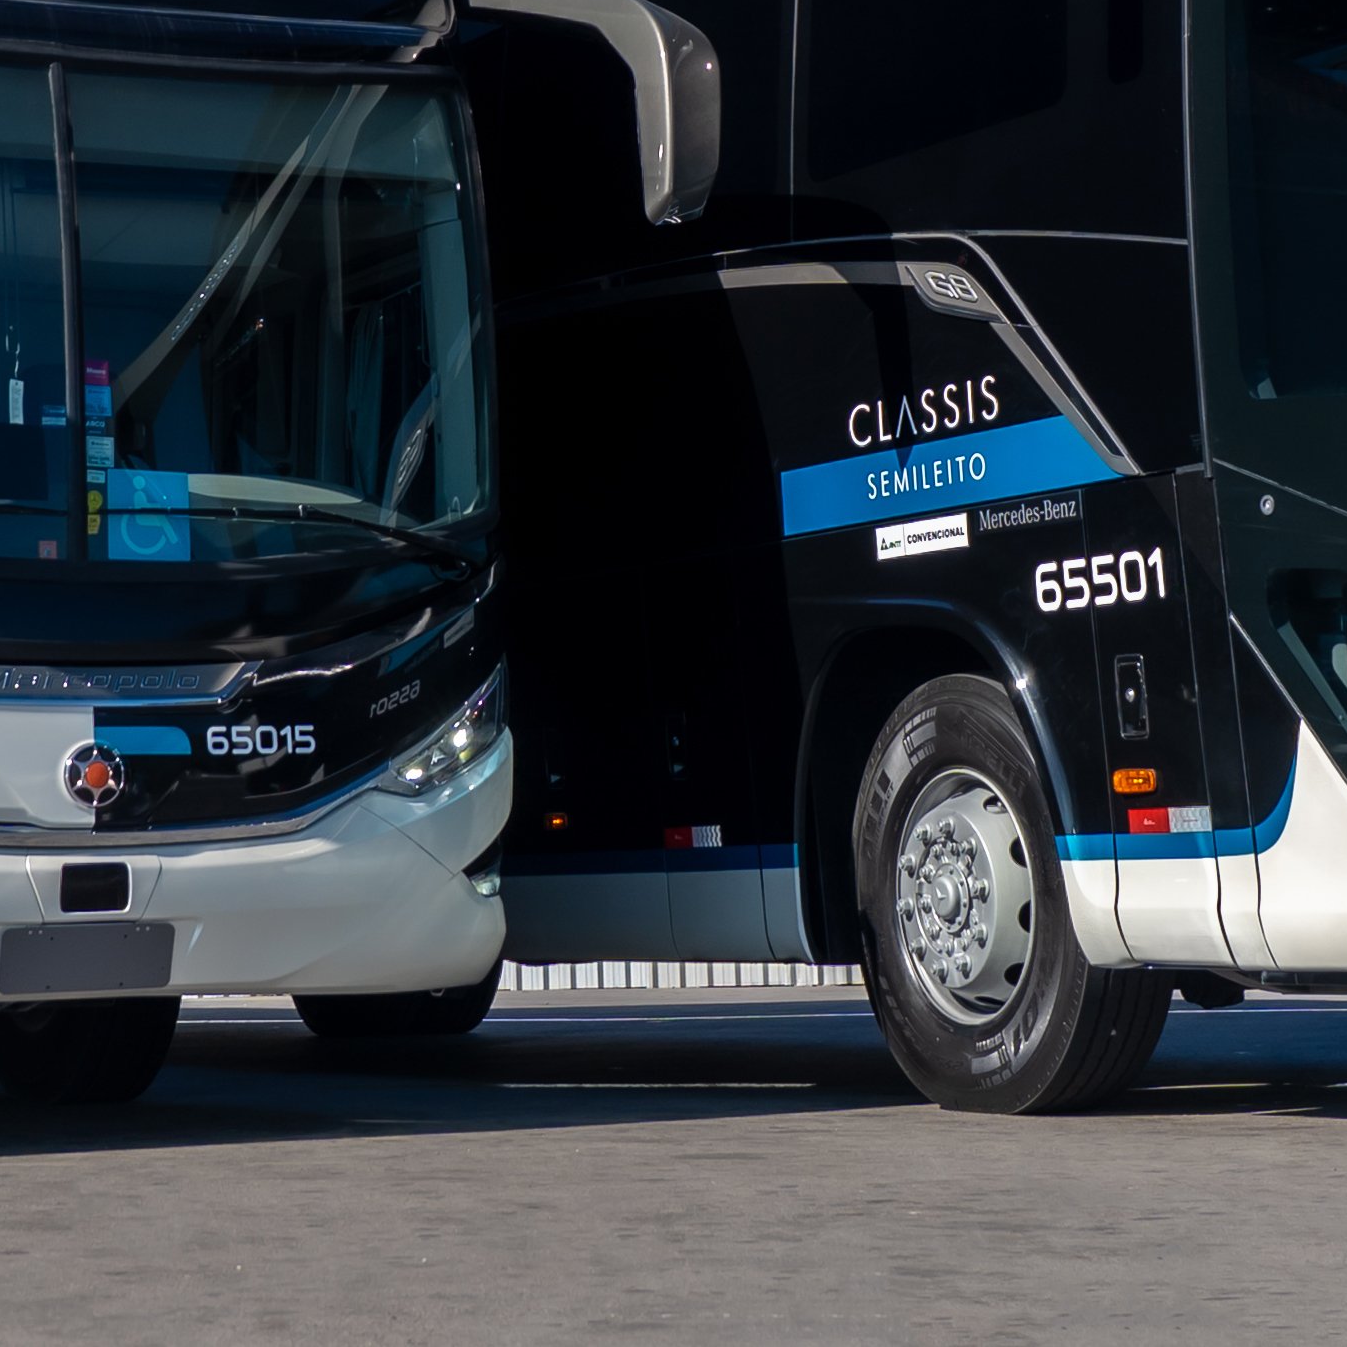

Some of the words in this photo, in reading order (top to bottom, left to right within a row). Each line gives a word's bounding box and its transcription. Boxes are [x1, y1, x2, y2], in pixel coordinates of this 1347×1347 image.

[924, 270, 979, 303] G8
[848, 375, 999, 447] CLASSIS
[867, 452, 986, 500] SEMILEITO
[978, 499, 1077, 532] Mercedes-Benz
[906, 526, 965, 545] CONVENCIONAL
[1035, 546, 1166, 613] 65501
[206, 724, 317, 755] 65015
